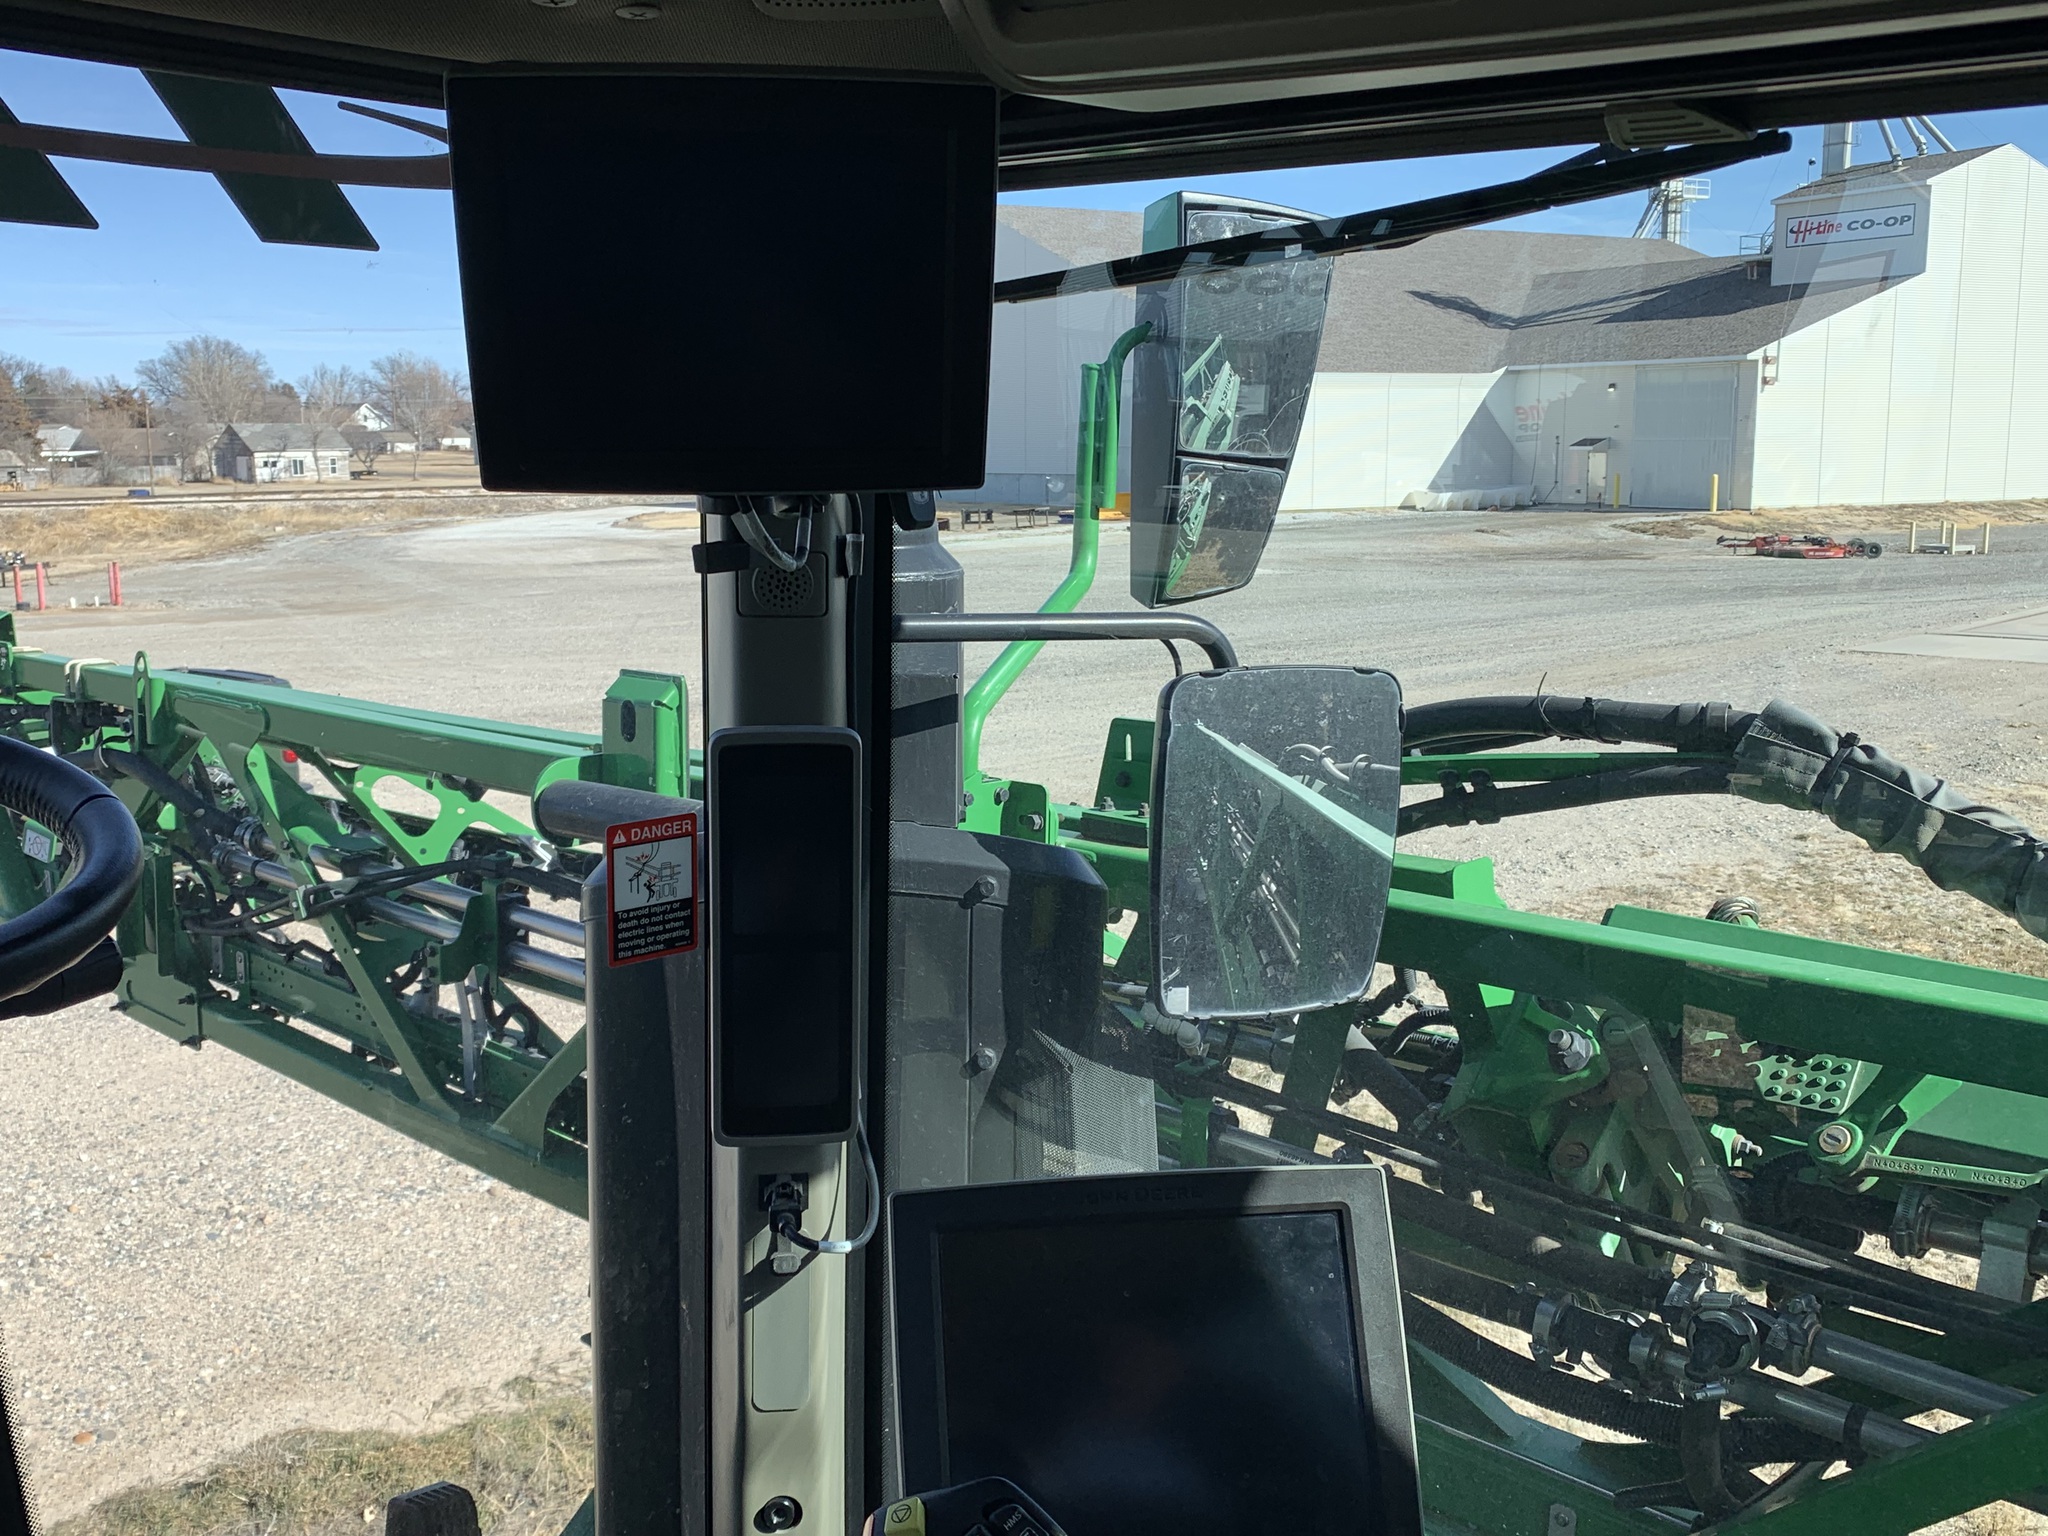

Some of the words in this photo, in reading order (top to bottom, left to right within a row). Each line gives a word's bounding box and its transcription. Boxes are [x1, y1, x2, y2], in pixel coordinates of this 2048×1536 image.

[1846, 214, 1912, 232] CO-OP
[631, 819, 692, 842] DANGER
[617, 919, 638, 929] death
[651, 914, 663, 923] not
[664, 909, 691, 920] contact
[618, 911, 628, 920] To
[629, 907, 649, 917] avoid
[650, 903, 671, 914] injury
[617, 928, 645, 939] electric
[646, 925, 664, 933] lines
[665, 920, 684, 929] when
[618, 937, 646, 949] moving
[656, 928, 690, 942] operating
[618, 950, 632, 959] this
[633, 943, 667, 955] machine.
[1930, 1166, 1959, 1178] RAW
[1971, 1171, 2028, 1188] N404840
[1003, 1510, 1022, 1531] HMS
